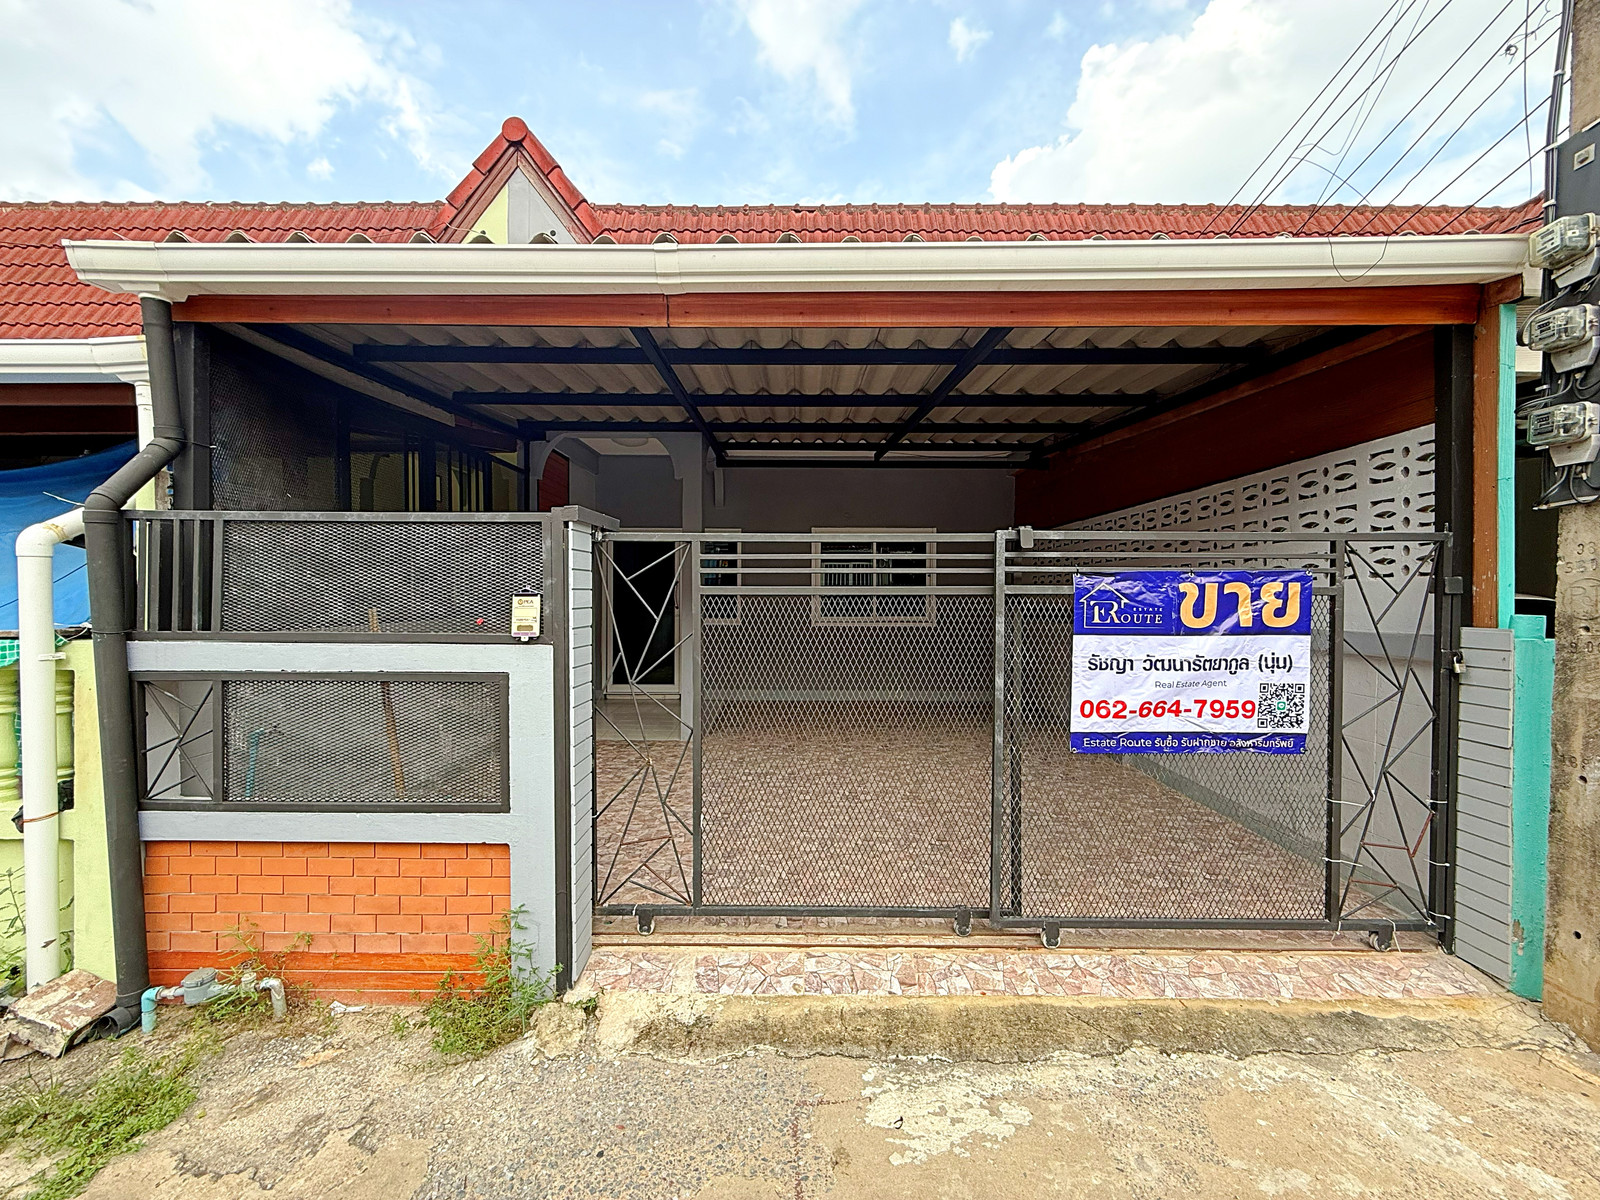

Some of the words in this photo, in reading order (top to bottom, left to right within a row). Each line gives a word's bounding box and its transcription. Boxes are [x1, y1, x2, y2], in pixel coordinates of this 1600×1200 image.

[1178, 581, 1301, 628] ขาย
[1088, 653, 1134, 675] รัชญา
[1142, 653, 1250, 675] วัฒนารัตยากูล
[1258, 652, 1293, 674] (นุ่น)
[1154, 680, 1175, 689] Real
[1175, 680, 1200, 689] Estate
[1201, 679, 1228, 689] Agent
[1079, 699, 1256, 719] 062-664-7959
[1083, 737, 1117, 747] Estate
[1119, 737, 1152, 747] Route
[1154, 734, 1179, 747] รับซื้อ
